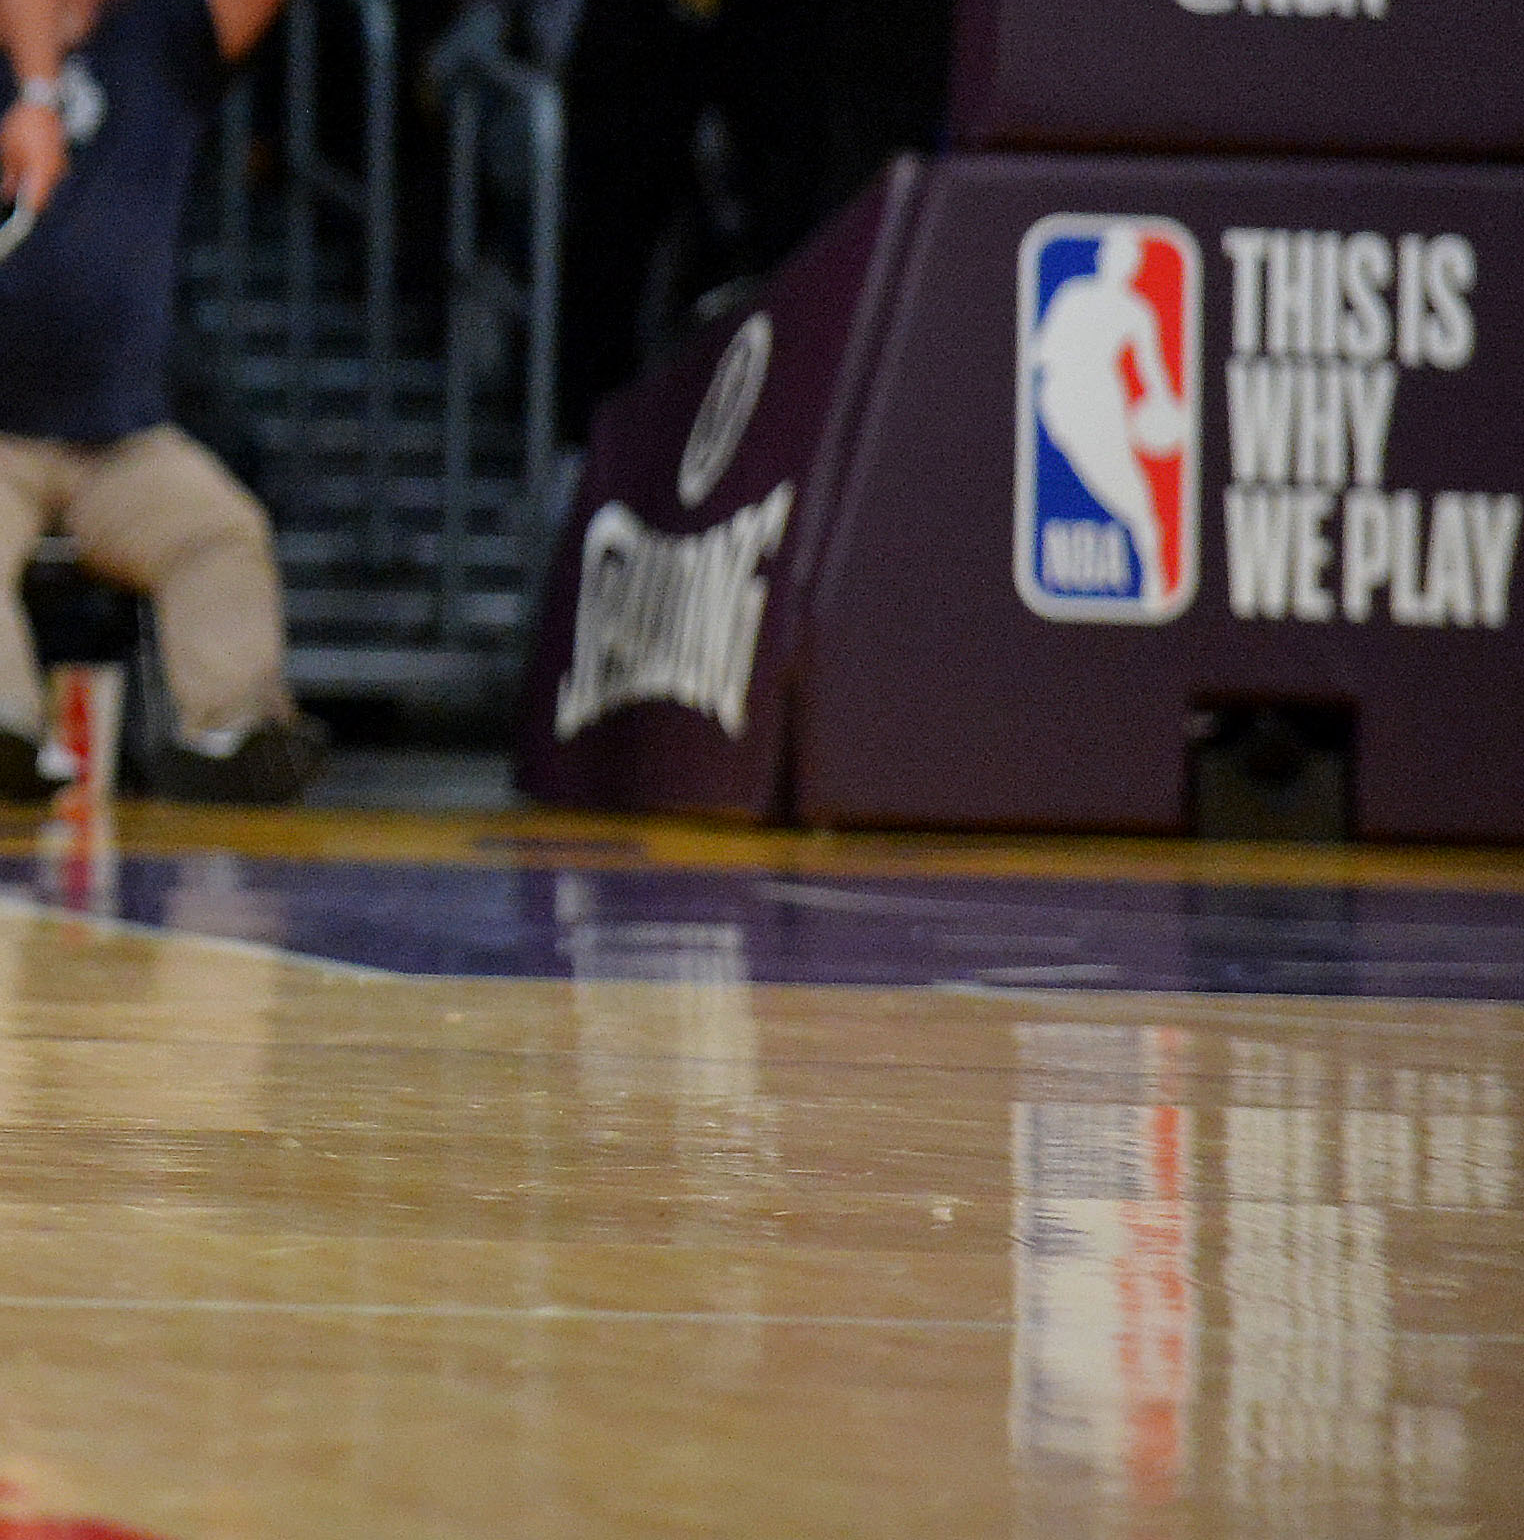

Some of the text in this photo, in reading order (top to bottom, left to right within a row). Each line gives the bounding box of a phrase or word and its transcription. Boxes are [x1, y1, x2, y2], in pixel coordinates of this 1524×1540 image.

[1222, 227, 1478, 371] THIS IS
[1225, 358, 1398, 485] WHY
[1042, 519, 1130, 589] NBA
[1223, 483, 1523, 631] WE PLAY
